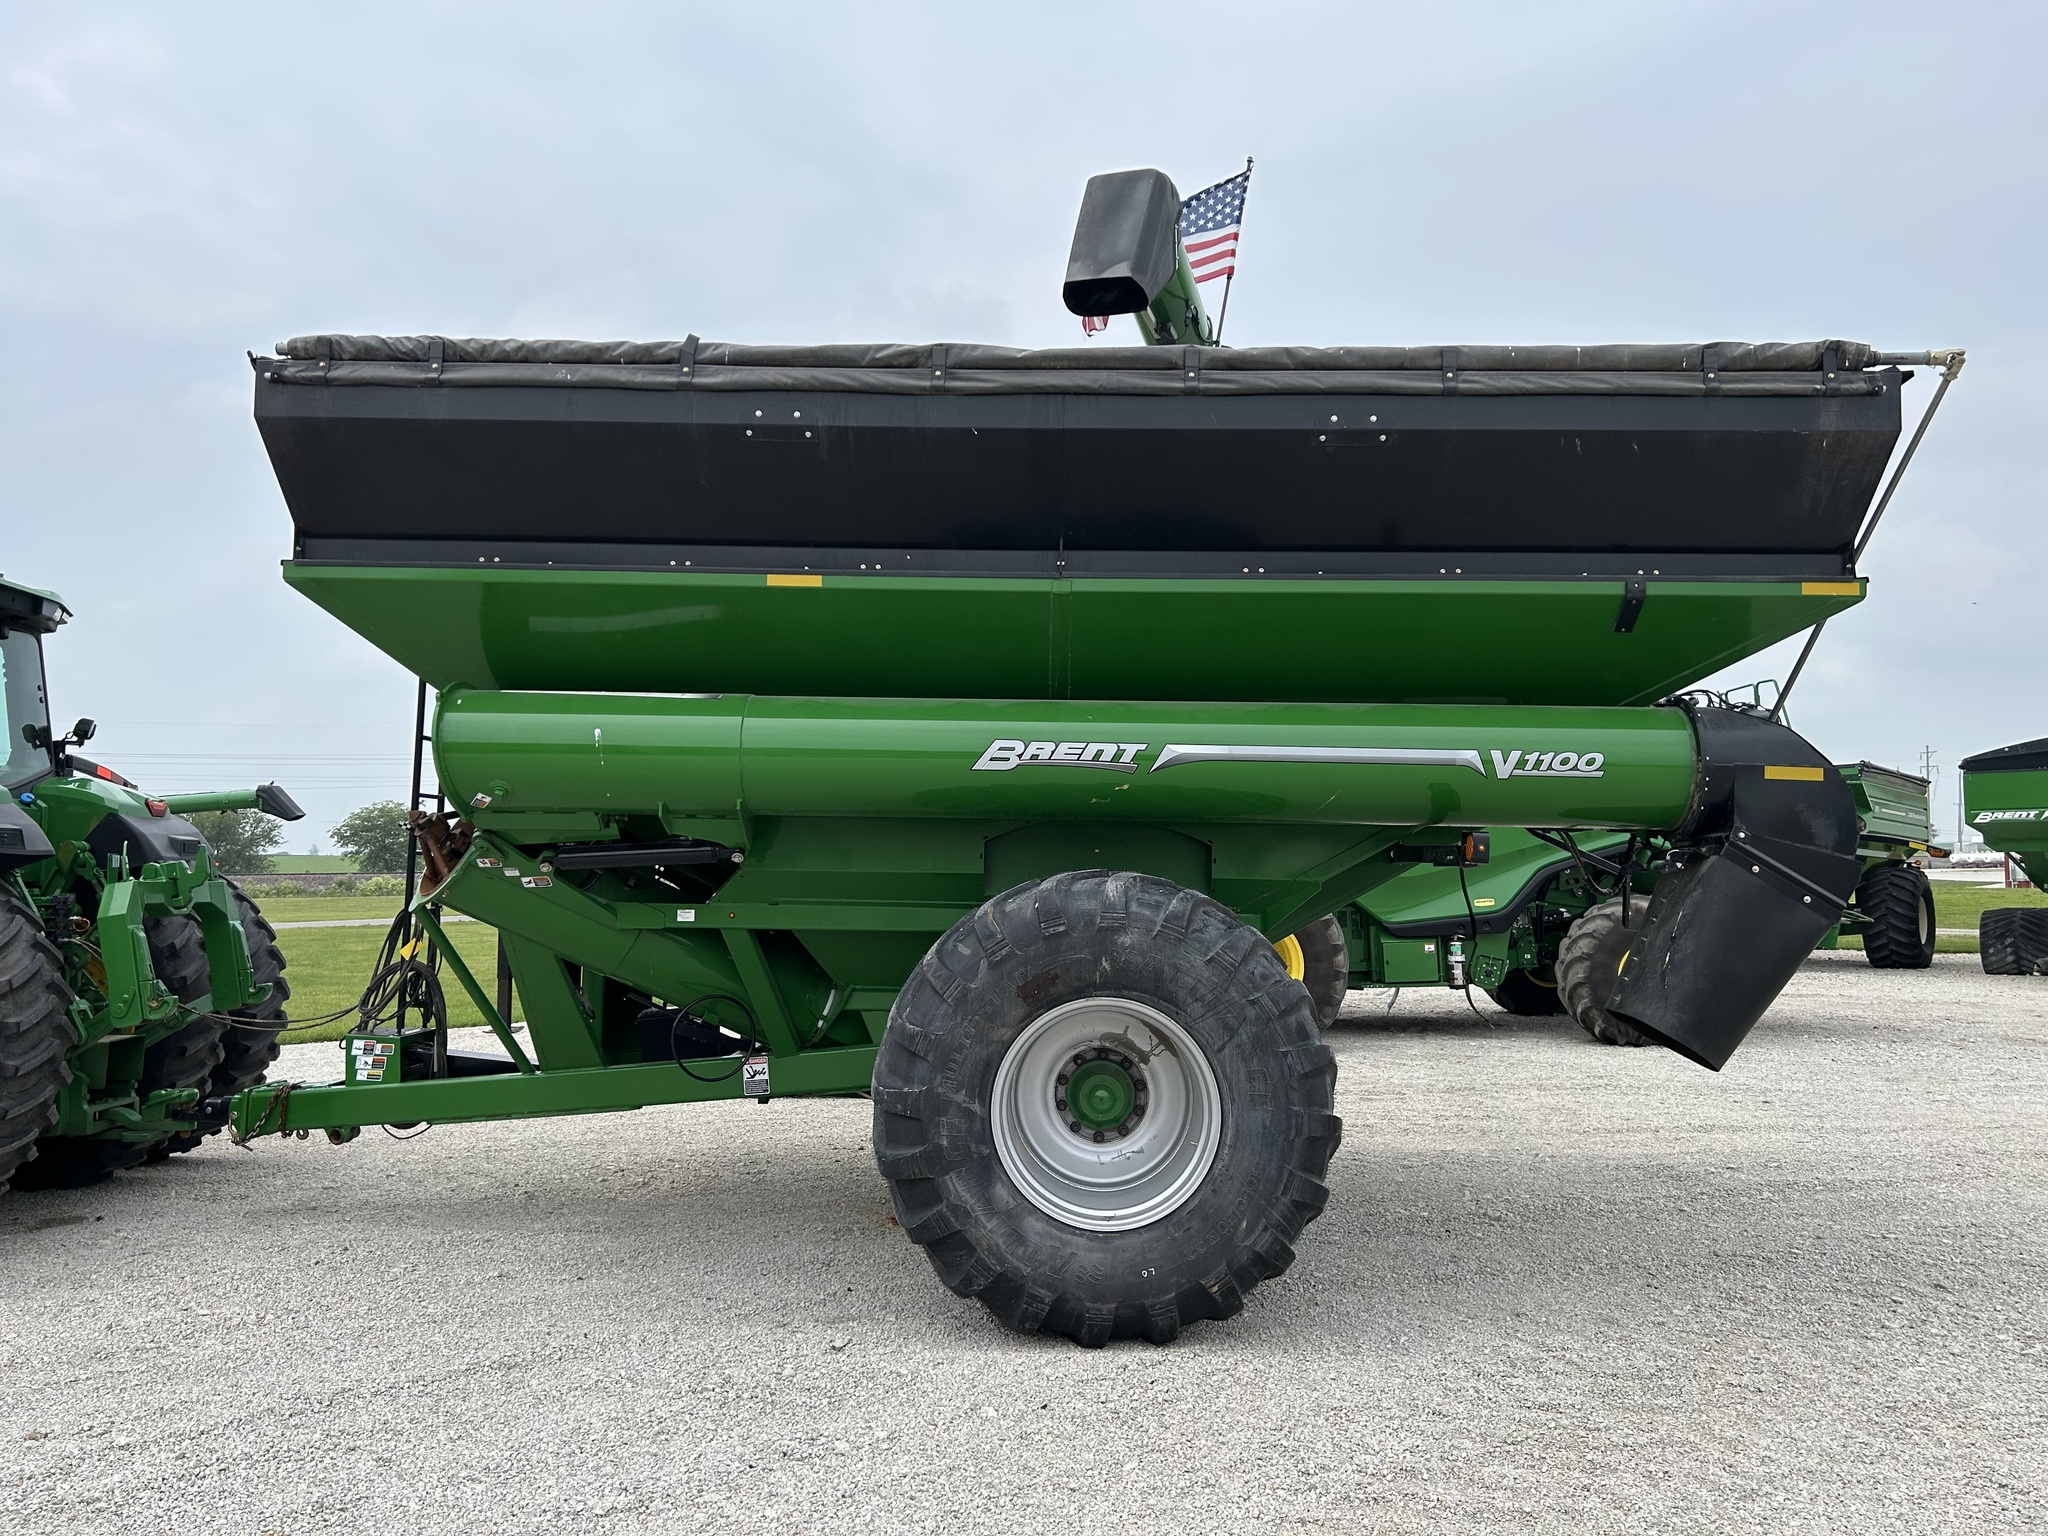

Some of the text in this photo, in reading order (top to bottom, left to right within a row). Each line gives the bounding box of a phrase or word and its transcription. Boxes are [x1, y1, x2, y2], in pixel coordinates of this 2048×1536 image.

[970, 739, 1605, 780] BRENT V1100
[1973, 811, 2039, 824] BRENT
